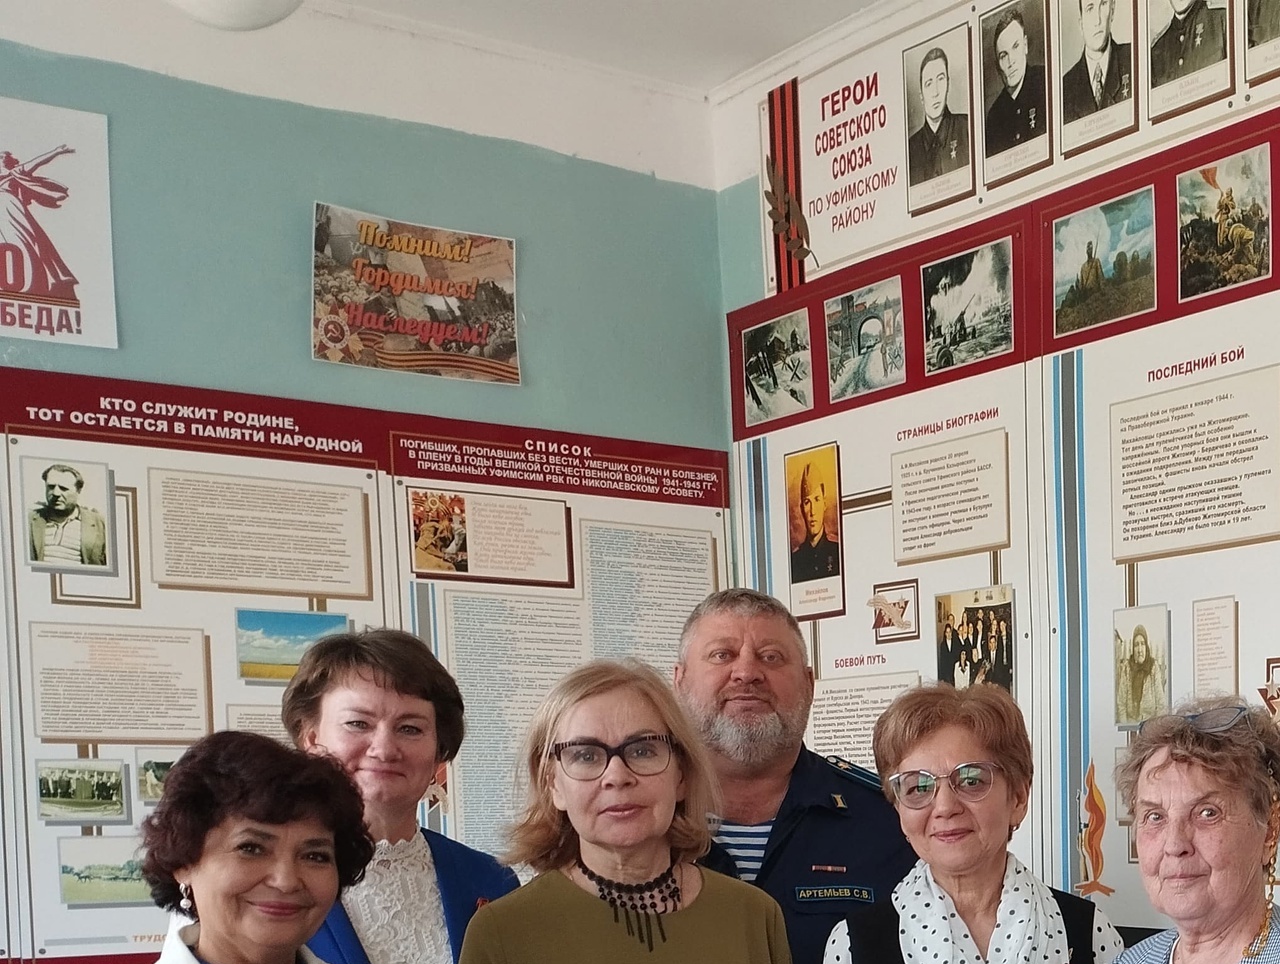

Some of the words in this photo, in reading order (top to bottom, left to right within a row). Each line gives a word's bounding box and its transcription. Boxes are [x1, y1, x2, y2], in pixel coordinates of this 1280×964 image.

[820, 72, 878, 121] ГЕРОИ
[815, 104, 886, 156] СОВЕТСКОГО
[832, 144, 872, 180] СОЮЗА
[809, 197, 823, 218] ПО
[825, 165, 898, 211] УФИМСКОМУ
[832, 199, 876, 232] РАЙОНУ
[357, 220, 472, 263] Помним!
[352, 258, 479, 300] Гордимся!
[344, 302, 490, 345] Наследуем!
[1147, 353, 1217, 382] ПОСЛЕДНИЙ
[1221, 346, 1245, 364] БОЙ
[25, 406, 65, 422] ТОТ
[69, 411, 168, 433] ОСТАЕТСЯ
[173, 421, 186, 434] В
[191, 423, 265, 443] ПАМЯТИ
[269, 431, 363, 454] НАРОДНОЙ
[100, 396, 137, 412] КТО
[142, 401, 218, 421] СЛУЖИТ
[223, 410, 299, 433] РОДИНЕ,
[897, 421, 944, 442] СТРАНИЦЫ
[946, 407, 999, 430] БИОГРАФИИ
[399, 438, 461, 455] ПОГИБШИХ,
[462, 445, 527, 461] ПРОПАВШИХ
[527, 452, 547, 464] БЕЗ
[548, 455, 582, 468] ВЕСТИ,
[583, 459, 630, 473] УМЕРШИХ
[630, 464, 643, 475] ОТ
[644, 466, 662, 476] РАН
[663, 468, 670, 477] И
[672, 469, 719, 483] БОЛЕЗНЕЙ,
[524, 440, 592, 457] СПИСОК
[408, 449, 416, 459] В
[418, 450, 453, 462] ПЛЕНУ
[454, 454, 462, 464] В
[463, 455, 493, 468] ГОДЫ
[494, 458, 541, 472] ВЕЛИКОЙ
[542, 464, 623, 481] ОТЕЧЕСТВЕННОЙ
[624, 473, 658, 485] ВОЙНЫ
[662, 477, 701, 490] 1941-1945
[417, 460, 487, 476] ПРИЗВАННЫХ
[489, 467, 544, 482] УФИМСКИМ
[545, 474, 565, 484] РВК
[566, 476, 581, 486] ПО
[581, 477, 660, 494] НИКОЛАЕВСКОМУ
[662, 486, 705, 499] С/СОВЕТУ.
[835, 655, 865, 669] БОЕВОЙ
[867, 654, 887, 666] ПУТЬ
[799, 889, 851, 899] АРТЕМЬЕВ
[854, 889, 871, 899] С.В.
